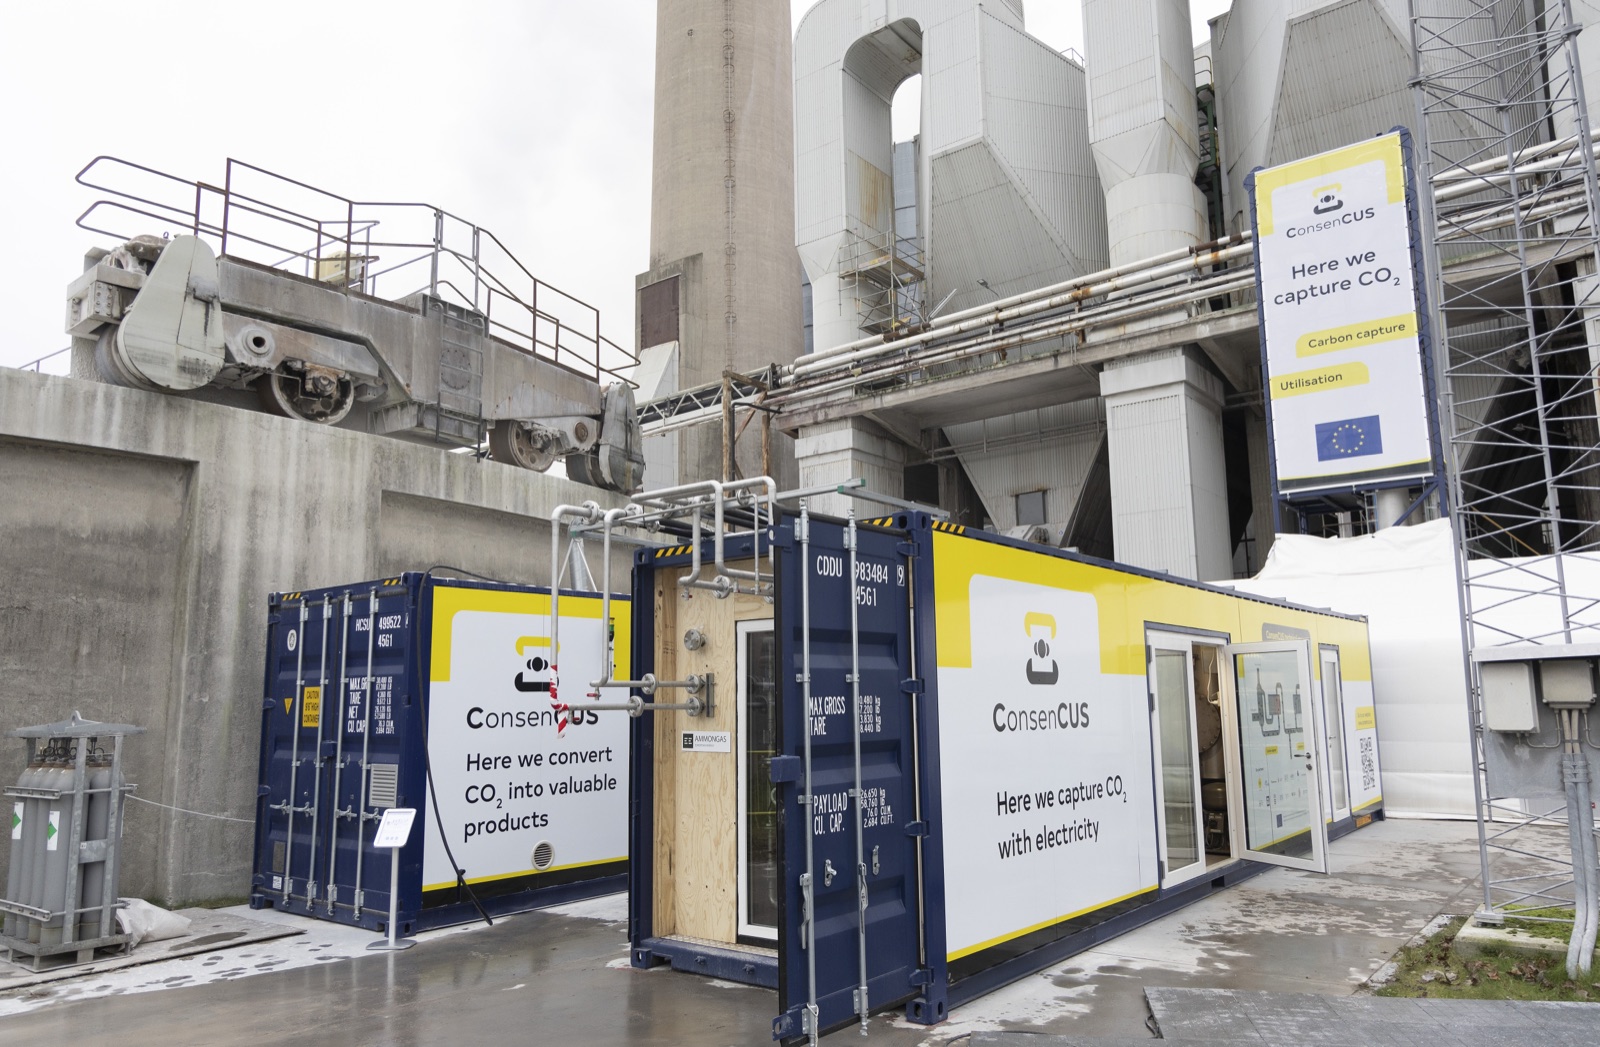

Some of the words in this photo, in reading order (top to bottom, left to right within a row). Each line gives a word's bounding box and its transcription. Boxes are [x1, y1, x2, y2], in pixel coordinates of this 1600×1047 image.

[1286, 207, 1375, 238] ConsenCUS
[1292, 256, 1340, 280] Here
[1346, 250, 1376, 268] we
[1274, 279, 1352, 305] capture
[1358, 267, 1400, 286] CO2
[1308, 332, 1353, 349] Carbon
[1356, 322, 1406, 341] capture
[1280, 372, 1342, 391] Utilisation
[816, 555, 842, 578] CDDU
[856, 560, 888, 584] 983484
[856, 585, 876, 606] 45G1
[378, 634, 392, 647] 45G1
[348, 706, 358, 718] NET
[809, 696, 823, 715] MAX
[824, 695, 846, 715] GROSS
[992, 702, 1090, 732] ConsenCUS
[810, 716, 826, 736] TARE
[467, 753, 512, 771] Here
[518, 753, 543, 767] we
[549, 747, 612, 765] convert
[465, 784, 502, 809] CO2
[509, 782, 543, 799] into
[549, 774, 617, 795] valuable
[814, 792, 848, 814] PAYLOAD
[997, 792, 1031, 816] Here
[1035, 790, 1054, 809] we
[1058, 780, 1103, 810] capture
[1106, 774, 1127, 803] CO2
[464, 812, 548, 842] products
[814, 815, 825, 835] CU.
[830, 813, 845, 833] CAP.
[998, 829, 1031, 859] with
[1036, 818, 1100, 851] electricity
